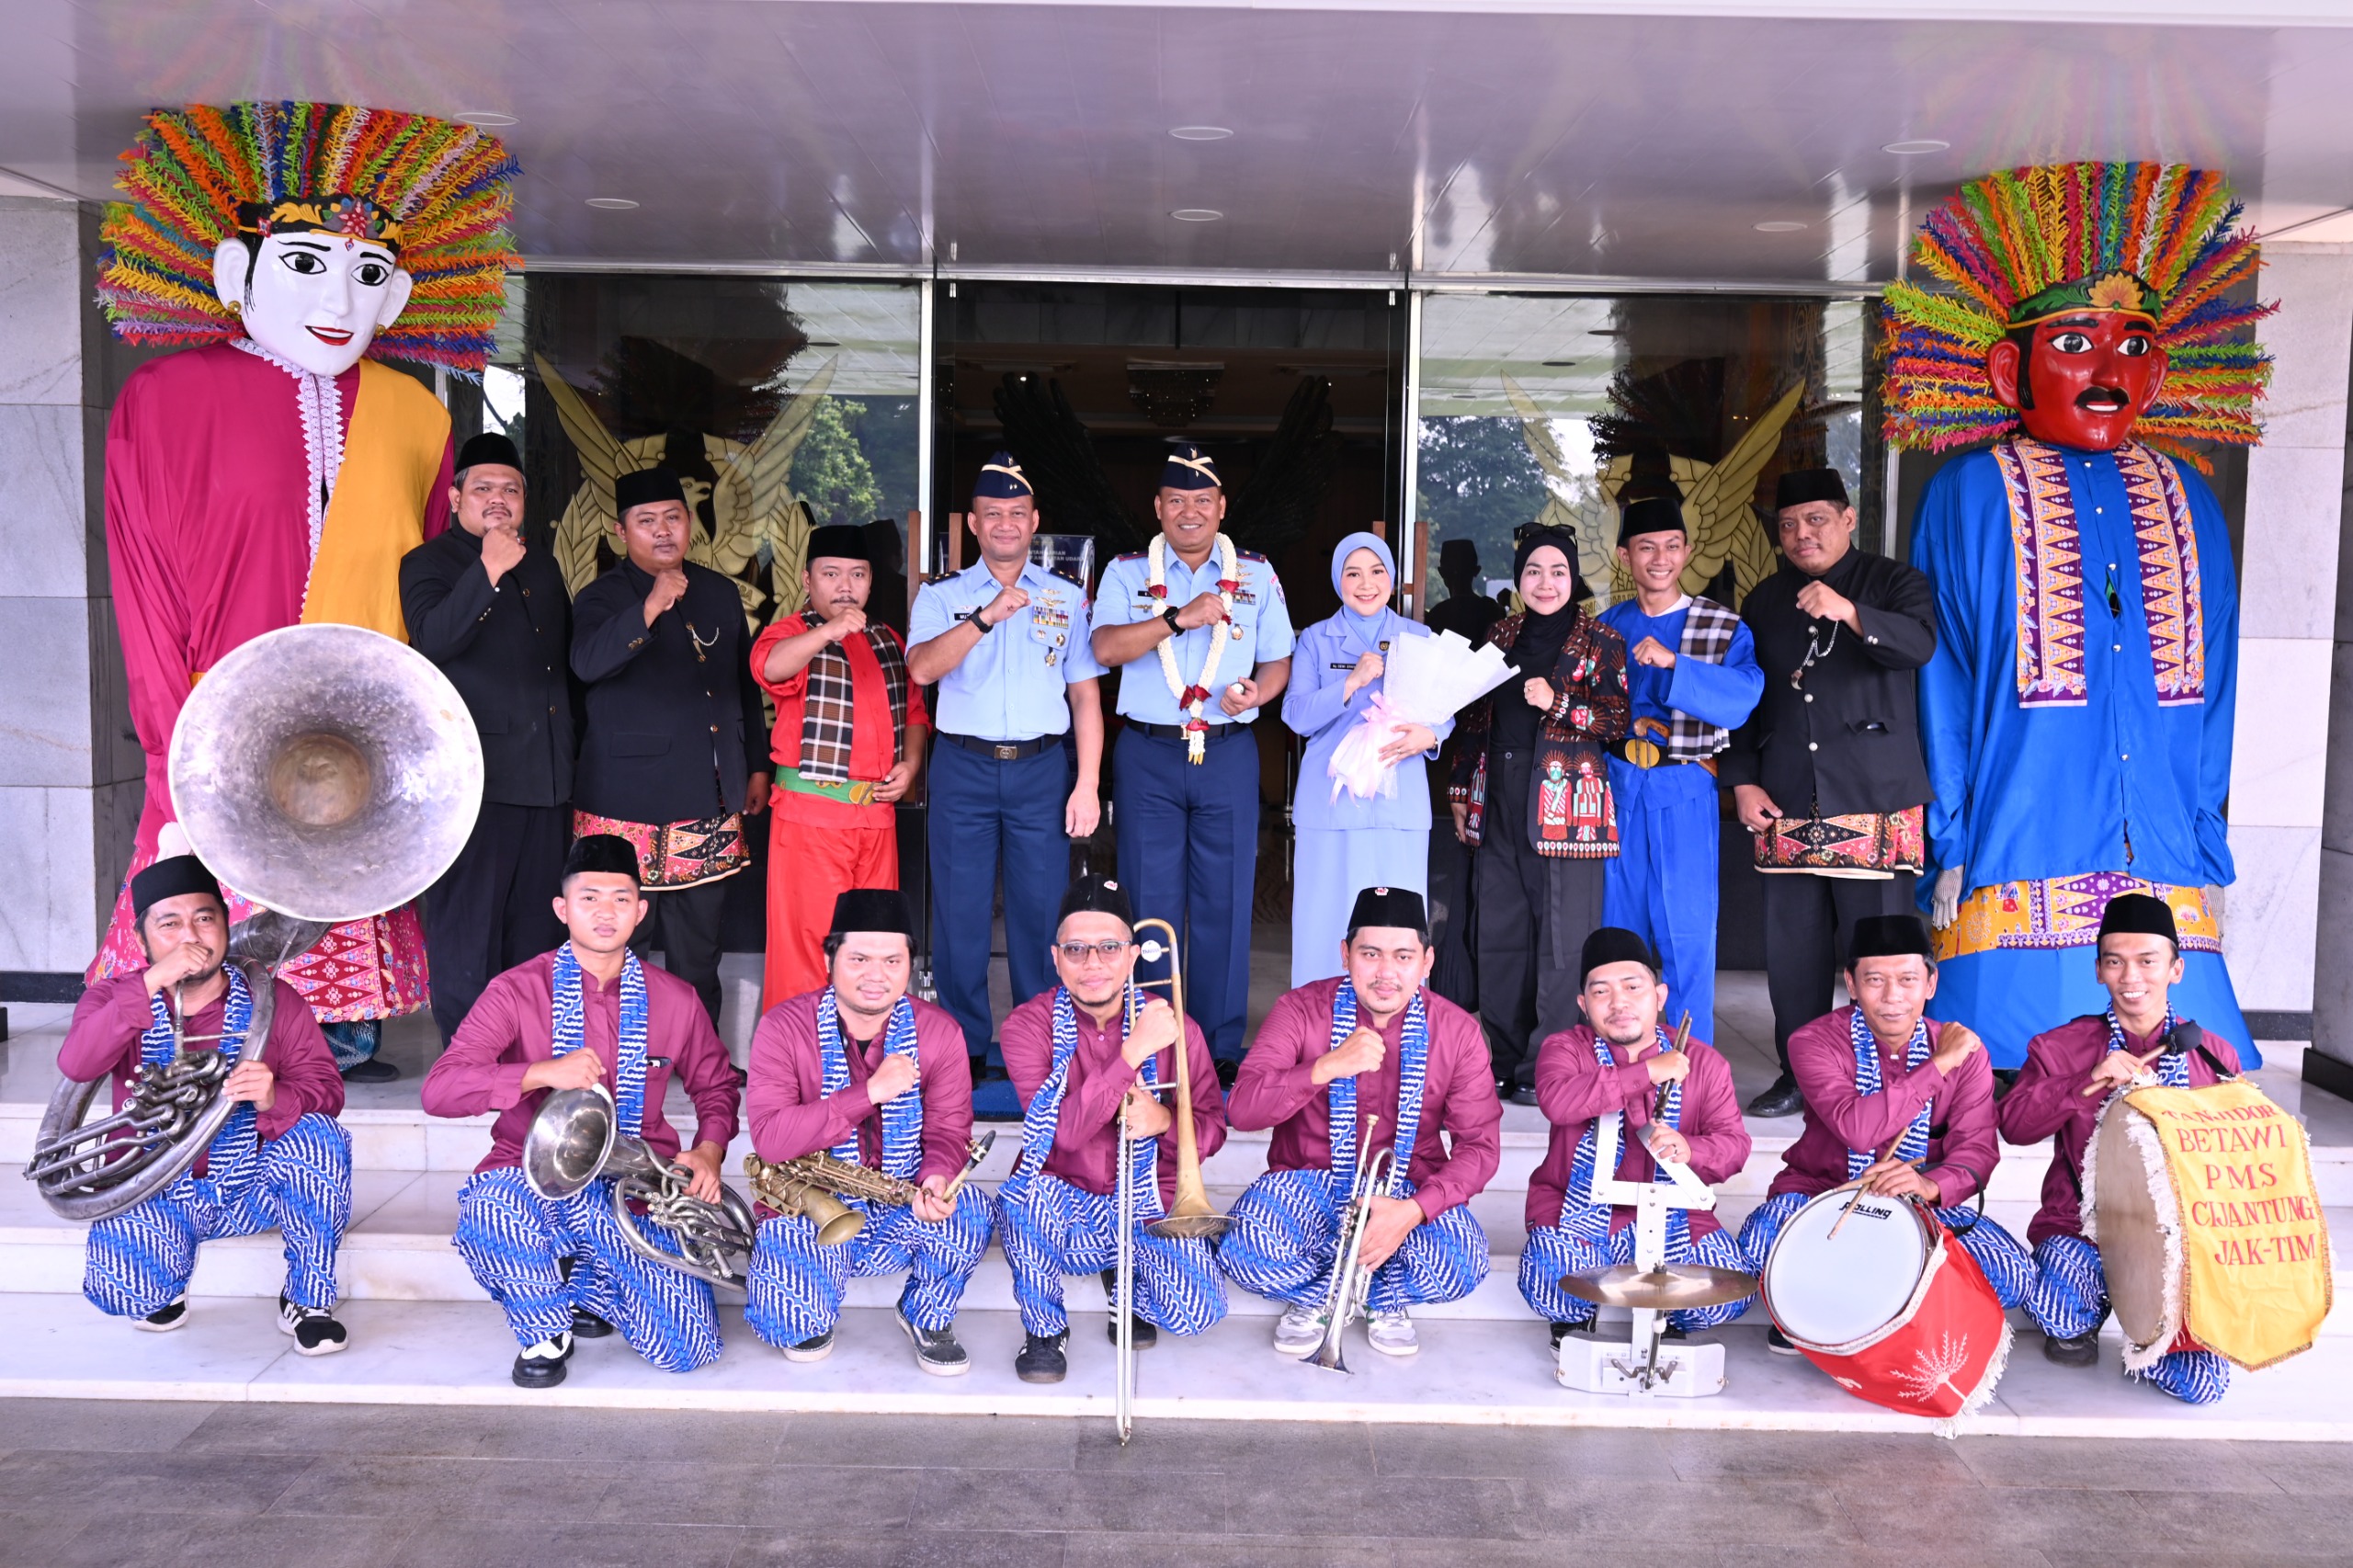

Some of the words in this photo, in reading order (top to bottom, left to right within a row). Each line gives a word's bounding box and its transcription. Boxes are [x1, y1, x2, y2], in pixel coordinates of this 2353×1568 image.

[2161, 1104, 2278, 1122] TANJIDOR
[2176, 1124, 2287, 1153] BETAWI
[2204, 1163, 2278, 1190] PMS
[2191, 1196, 2315, 1227] CIJANTUNG
[2214, 1233, 2315, 1266] JAK-TIM
